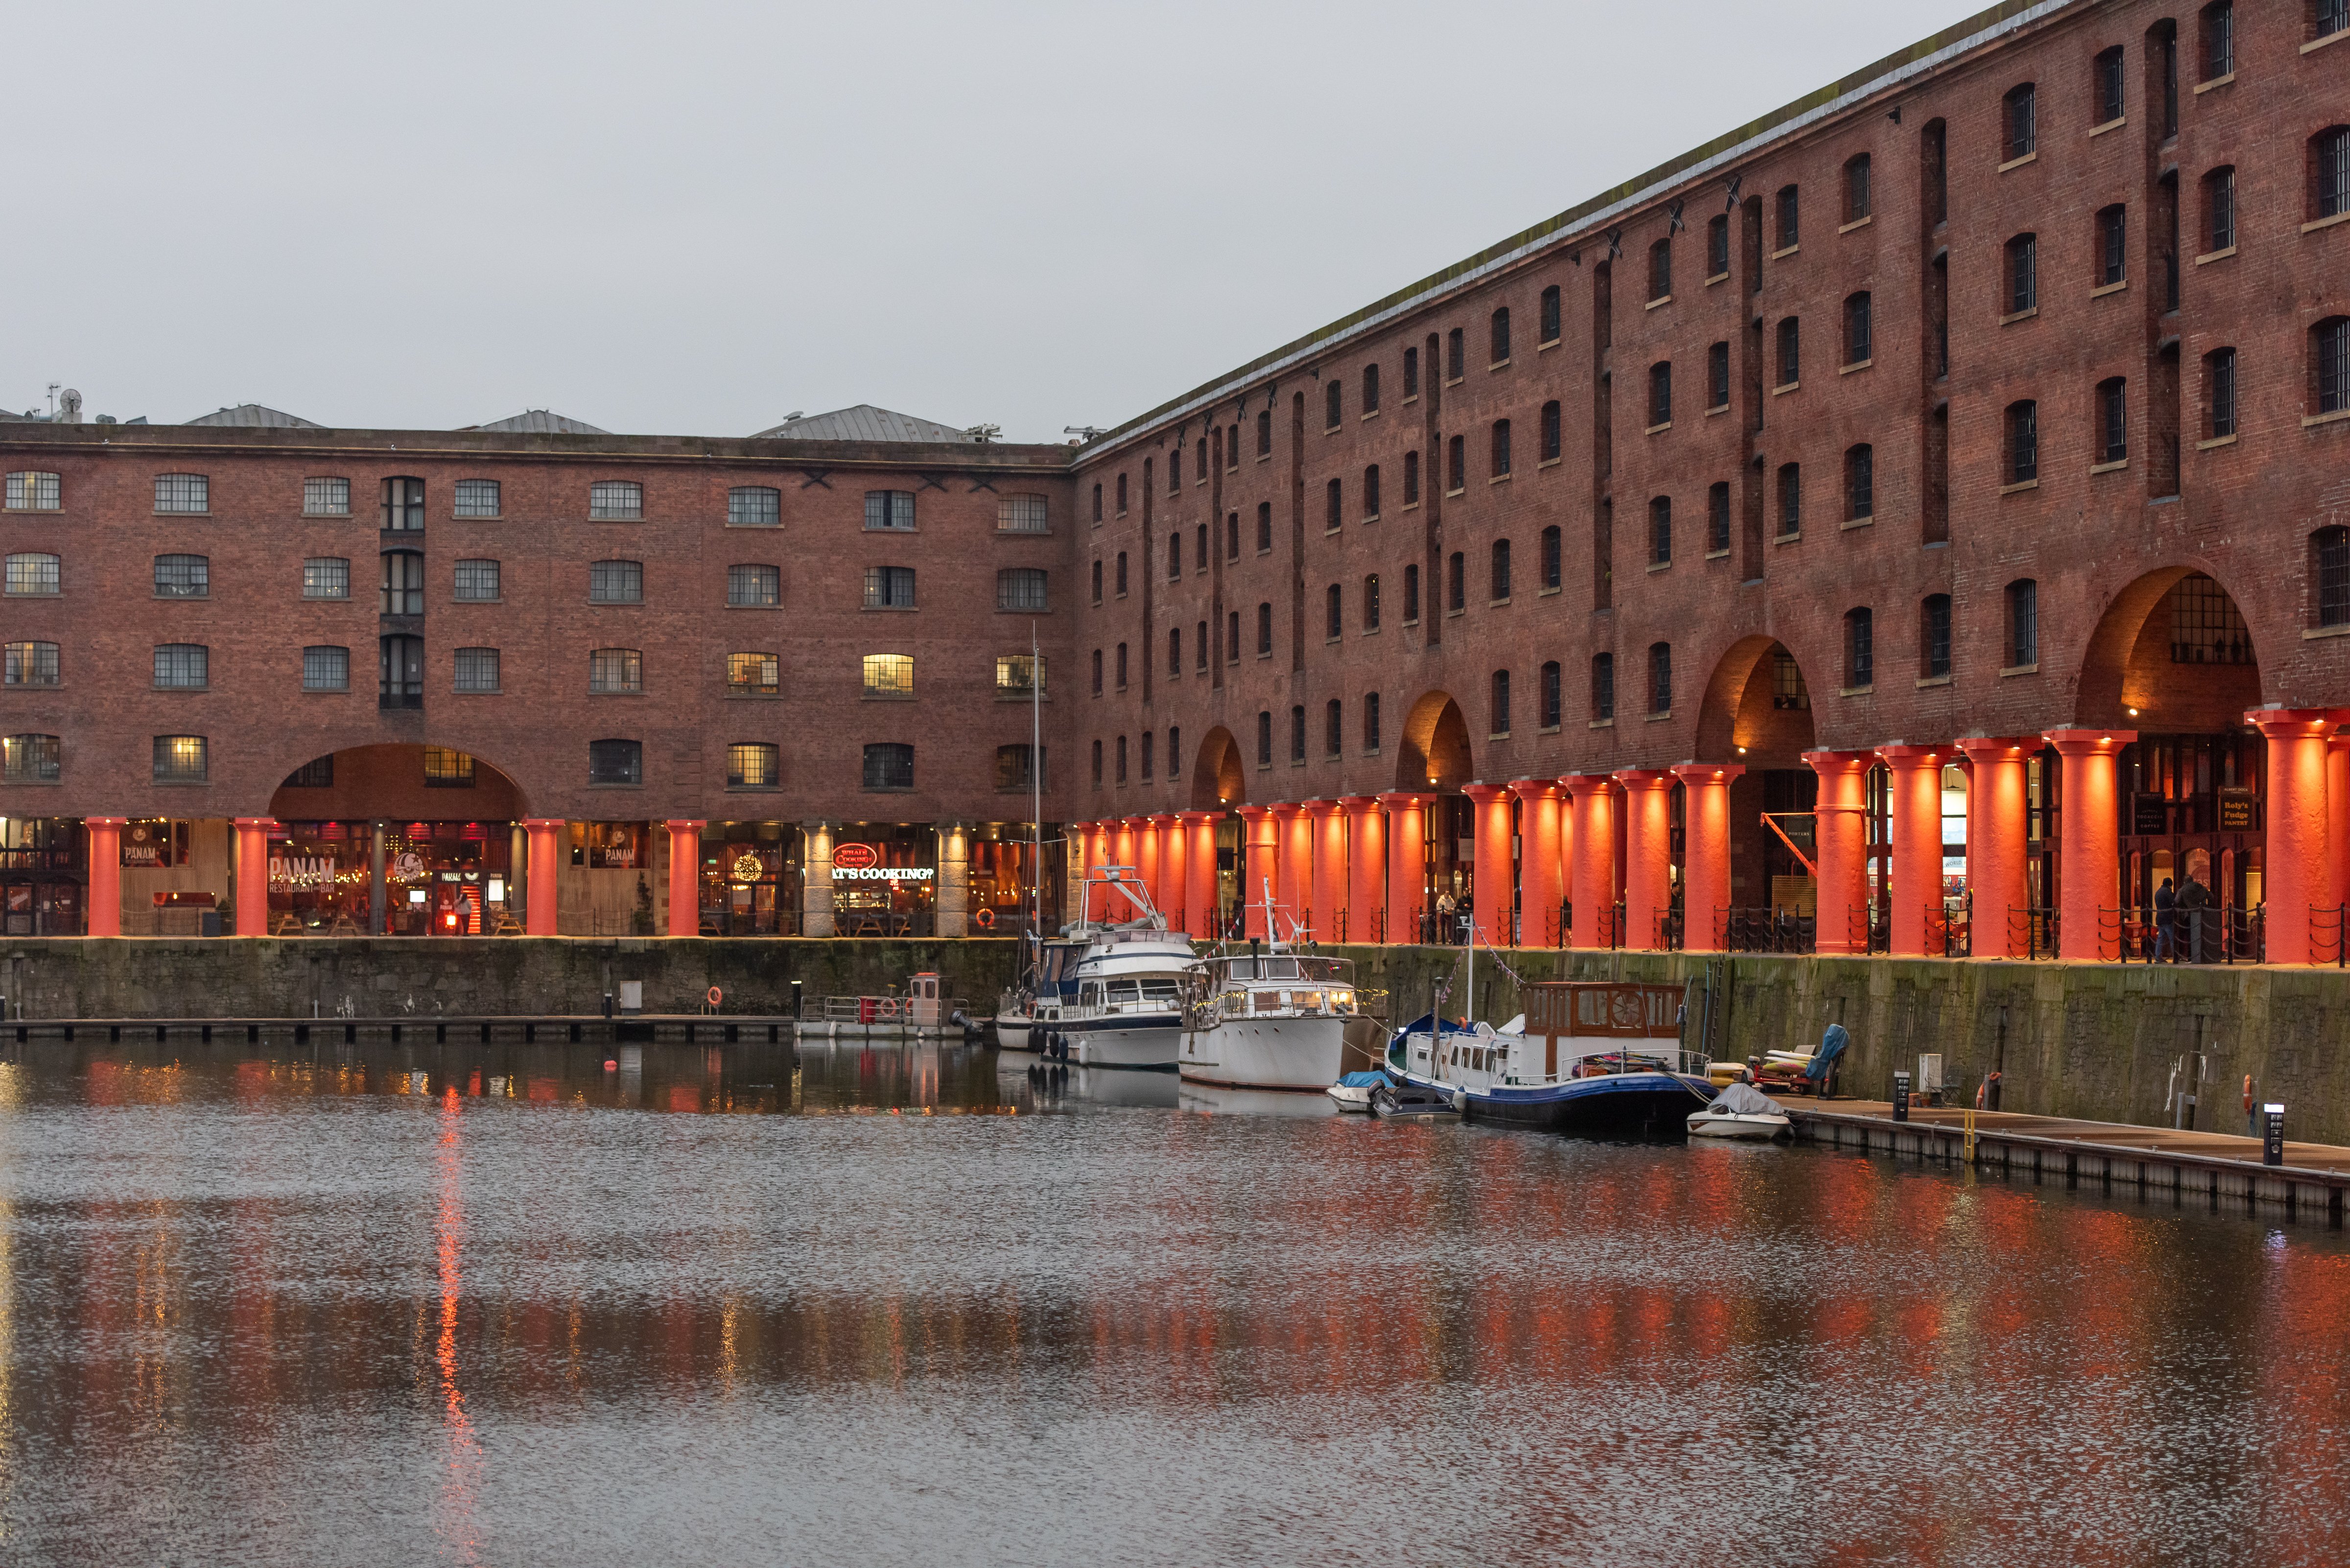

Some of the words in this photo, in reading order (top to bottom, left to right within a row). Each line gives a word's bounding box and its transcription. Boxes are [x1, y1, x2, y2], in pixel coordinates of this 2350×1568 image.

[124, 847, 155, 859] PANAM
[606, 849, 634, 860] PANAM
[270, 857, 334, 883] PANAM
[859, 867, 934, 880] COOKING?
[270, 884, 313, 892] RESTAURANT
[321, 884, 334, 892] BAR
